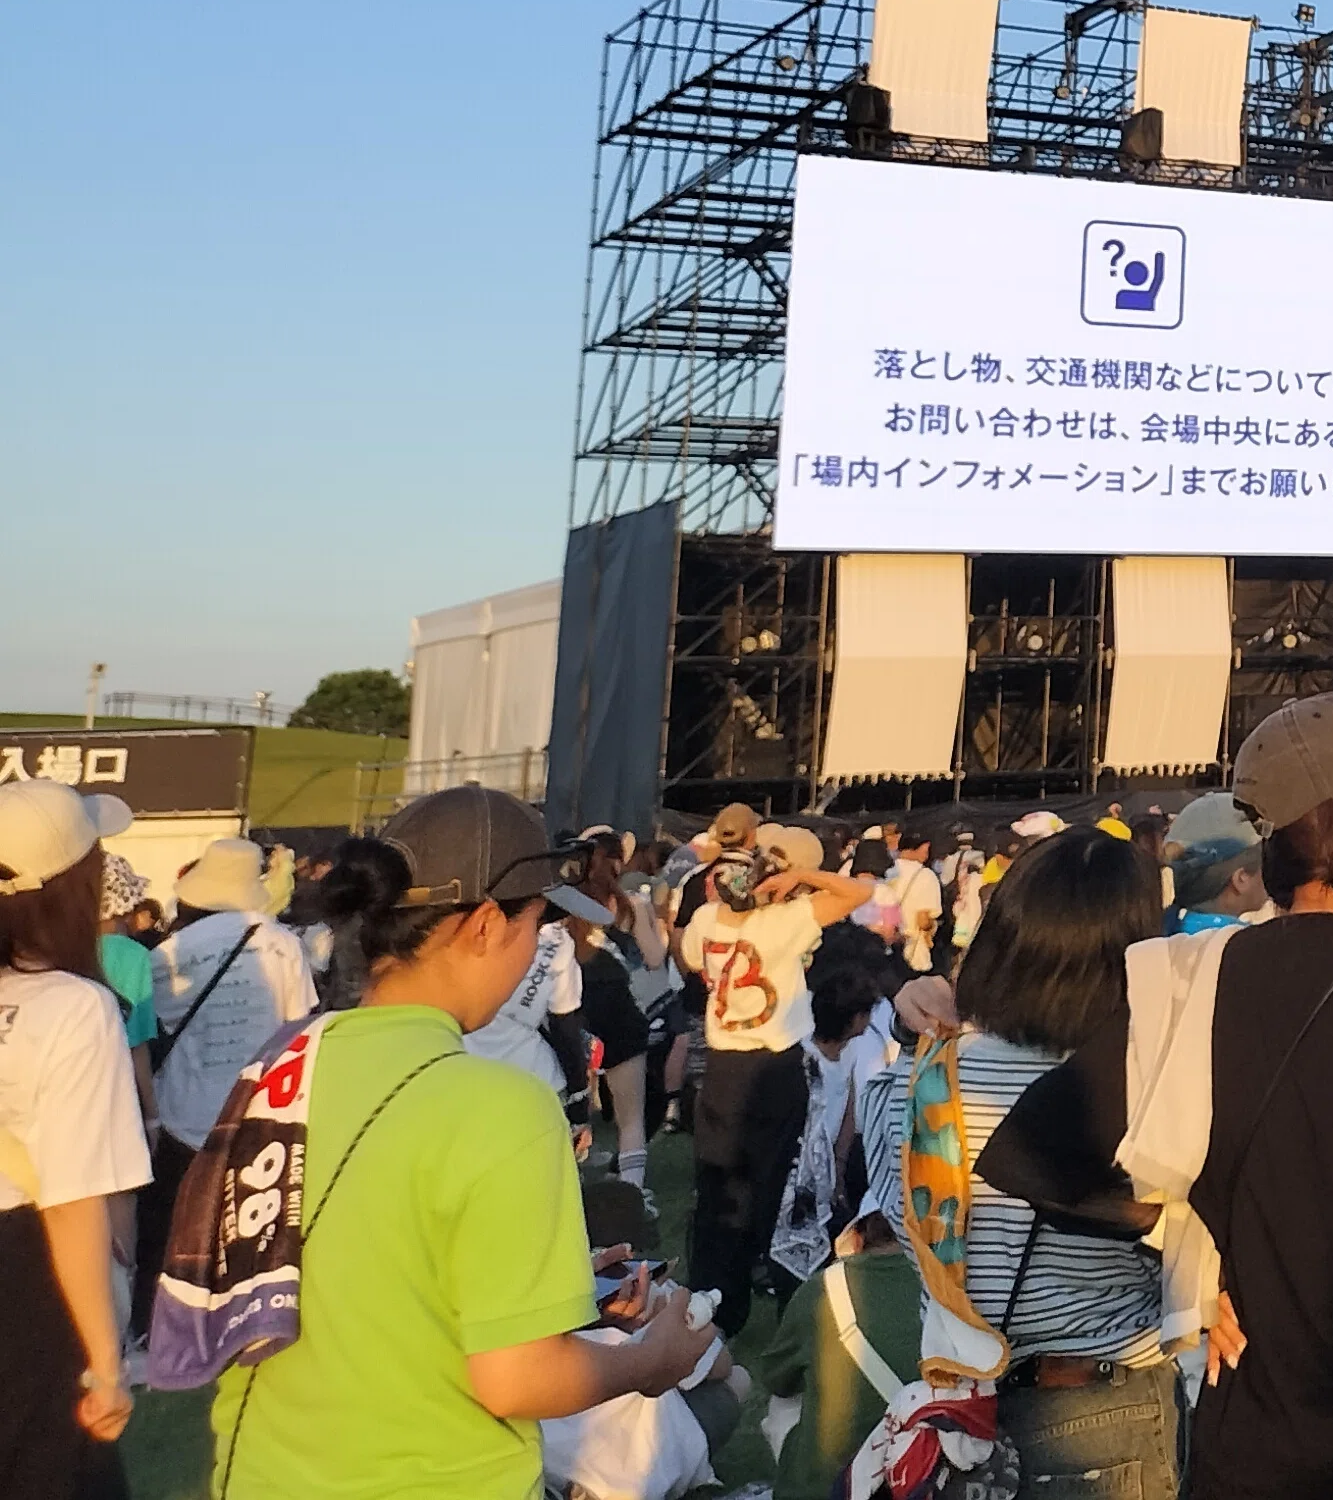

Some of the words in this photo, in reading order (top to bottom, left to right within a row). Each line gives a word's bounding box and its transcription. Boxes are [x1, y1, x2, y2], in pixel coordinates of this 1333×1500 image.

[0, 745, 128, 785] 入場口
[519, 962, 550, 1008] ROCK
[287, 1143, 306, 1187] MADE
[286, 1190, 304, 1228] WITH
